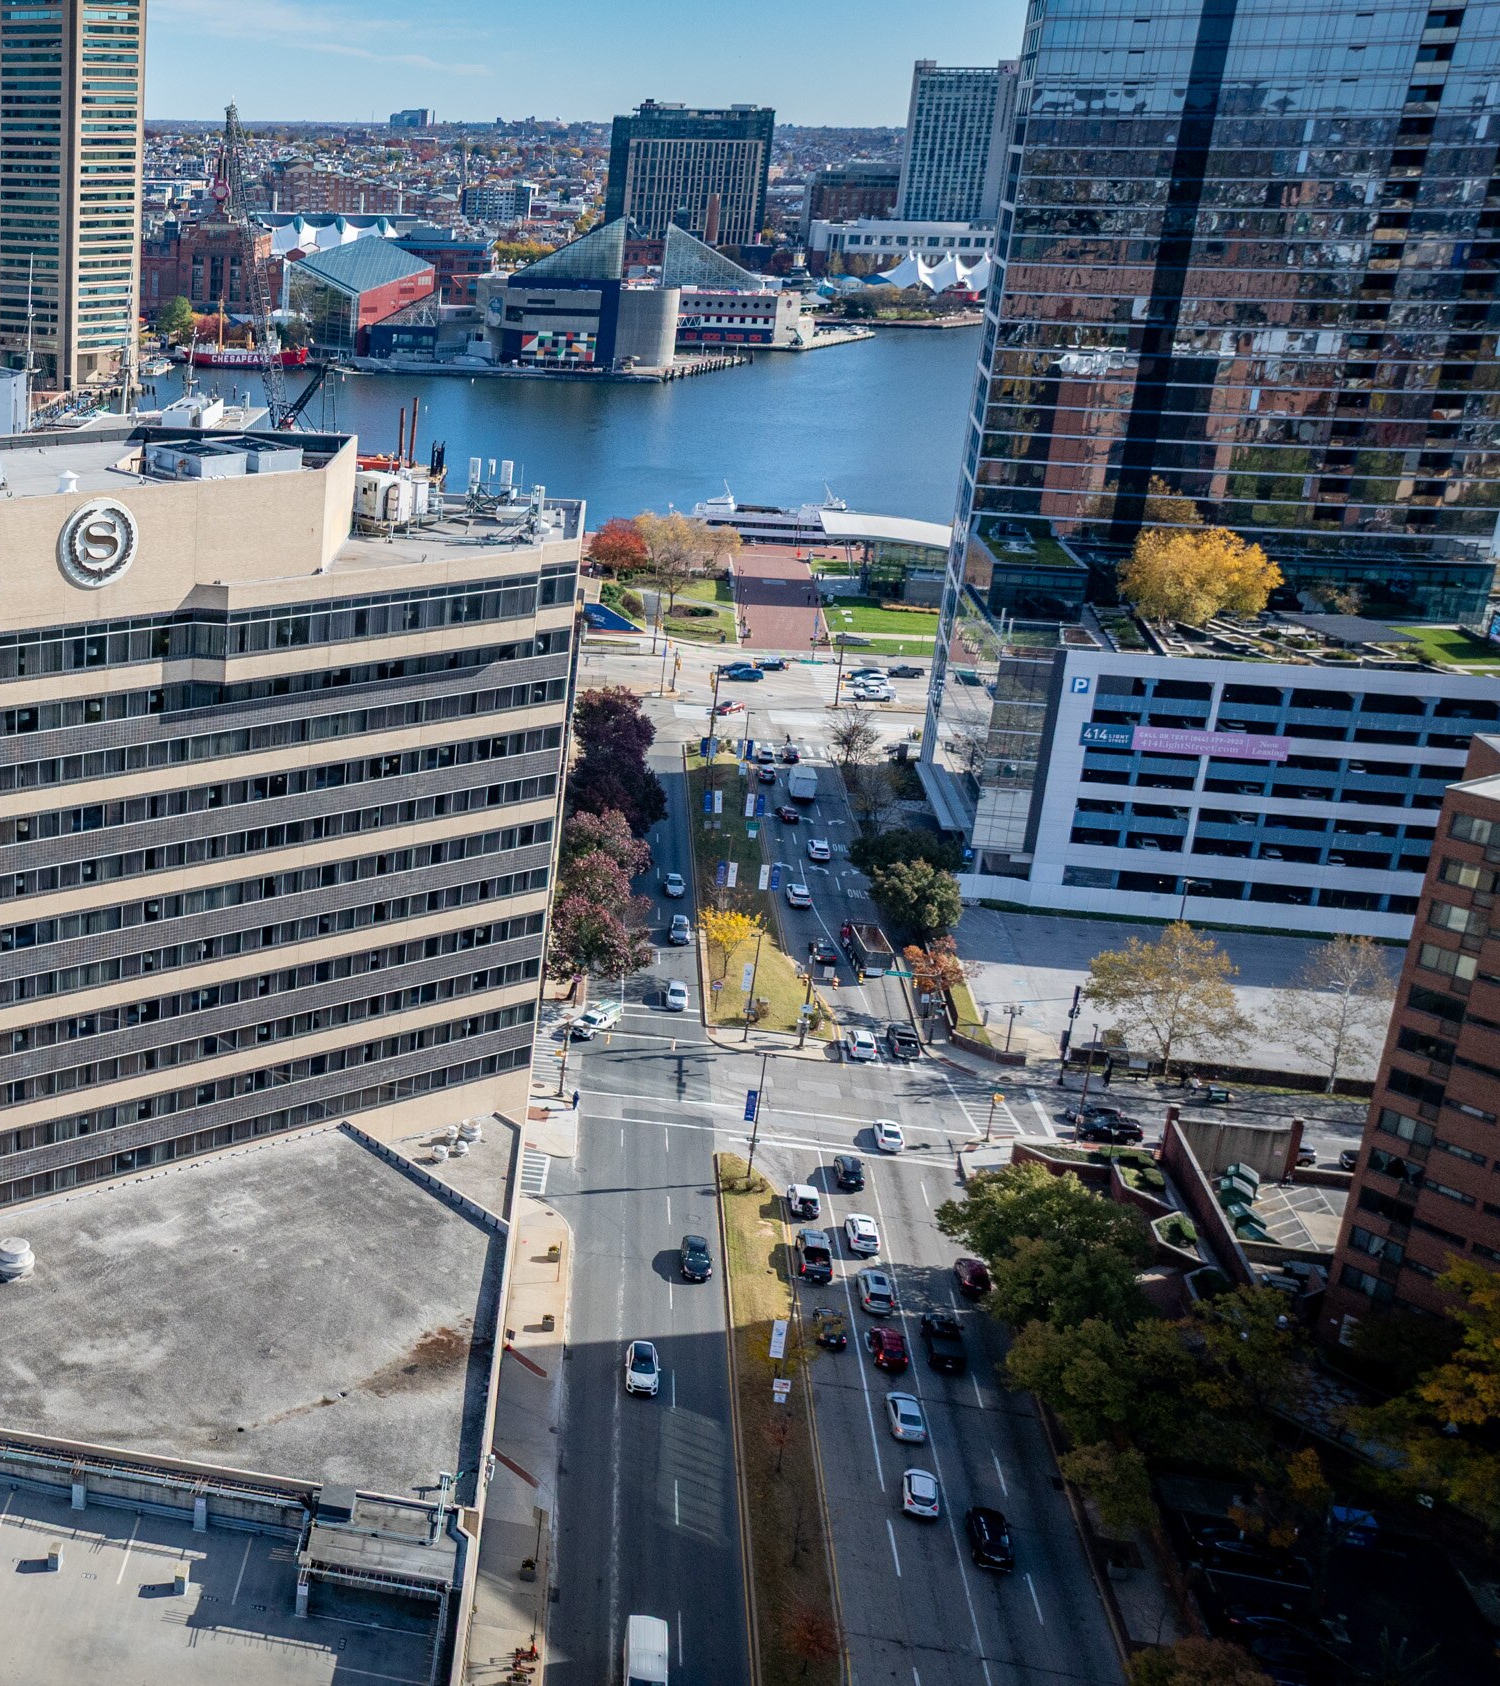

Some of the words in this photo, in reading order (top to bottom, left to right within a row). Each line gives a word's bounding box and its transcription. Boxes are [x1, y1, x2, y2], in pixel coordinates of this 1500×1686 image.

[84, 521, 118, 560] S
[1073, 678, 1088, 693] P
[1083, 728, 1108, 739] 414
[1139, 731, 1157, 739] CALL
[1171, 733, 1189, 741] TEXT
[1259, 740, 1279, 749] Now
[1251, 747, 1285, 758] Leasing
[832, 843, 850, 853] ONL
